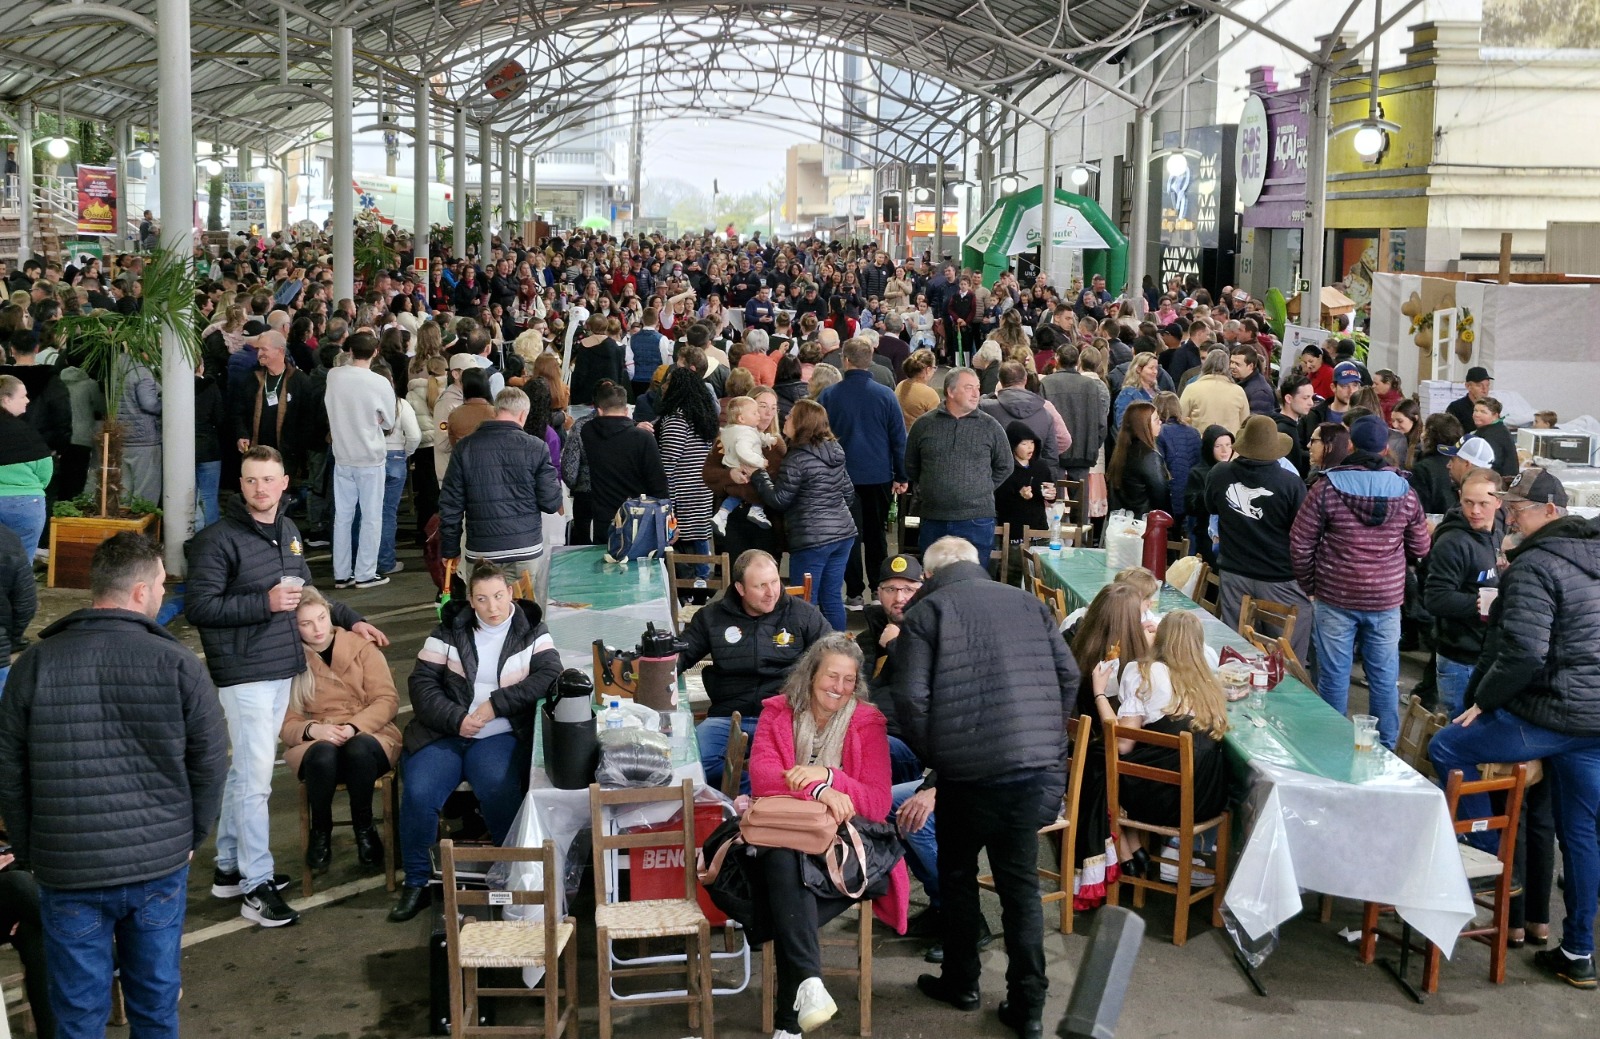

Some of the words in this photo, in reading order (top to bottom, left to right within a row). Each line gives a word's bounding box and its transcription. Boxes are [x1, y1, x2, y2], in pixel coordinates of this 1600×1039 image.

[1243, 126, 1260, 153] BOS
[1241, 153, 1260, 184] QUE
[1242, 258, 1251, 274] 151
